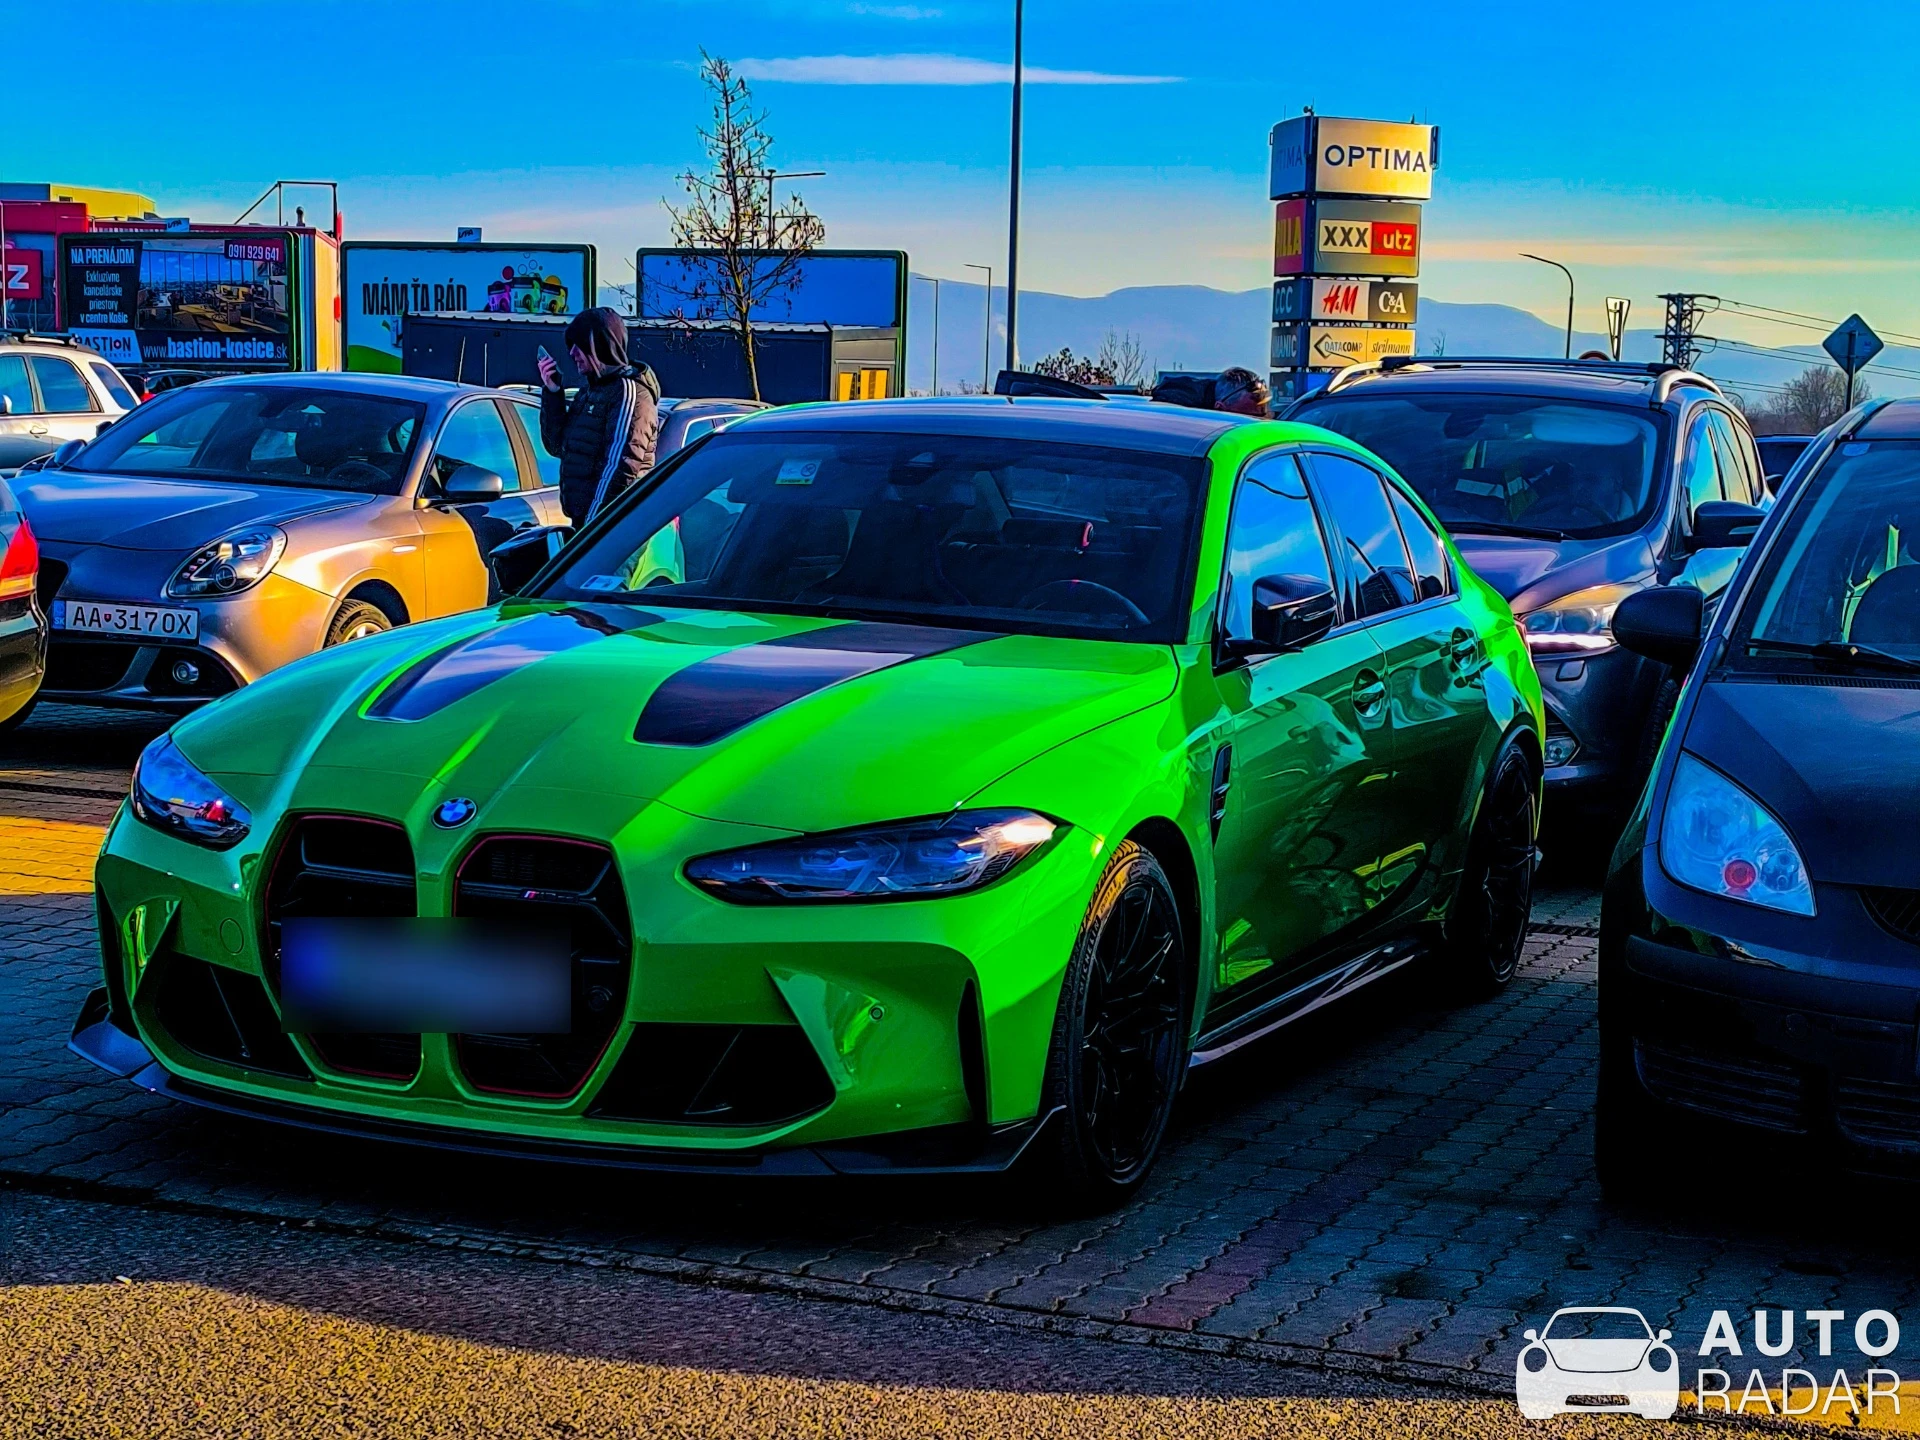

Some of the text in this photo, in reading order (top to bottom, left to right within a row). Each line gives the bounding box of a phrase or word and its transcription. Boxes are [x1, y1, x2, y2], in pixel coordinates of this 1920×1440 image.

[1324, 145, 1427, 172] OPTIMA
[71, 246, 134, 264] NA PRENÁJOM
[228, 244, 279, 261] 0911 929 641
[363, 277, 409, 315] MÁM
[434, 278, 467, 311] RÁD
[1275, 286, 1293, 315] CCC
[1323, 284, 1359, 316] H&M
[1378, 291, 1407, 313] C&A
[86, 313, 108, 323] centre
[143, 337, 287, 359] www.bastion-kosice.sk
[1325, 341, 1363, 352] DATACOMP
[54, 616, 65, 625] SK
